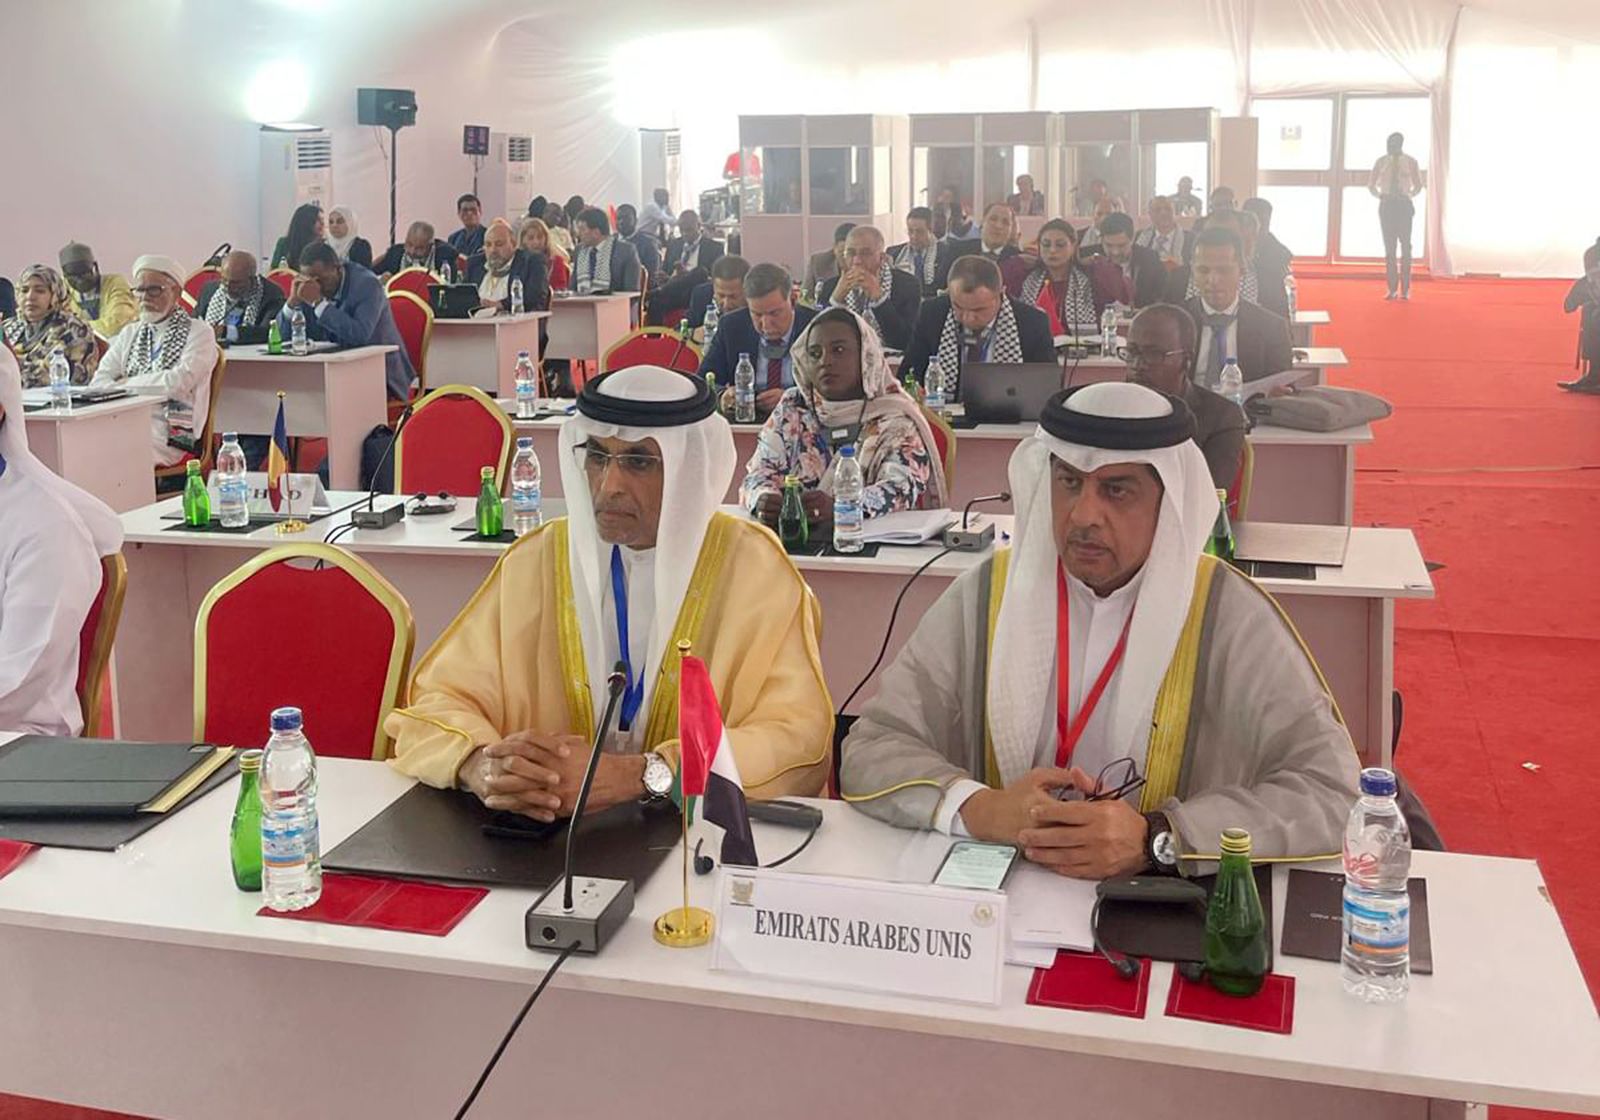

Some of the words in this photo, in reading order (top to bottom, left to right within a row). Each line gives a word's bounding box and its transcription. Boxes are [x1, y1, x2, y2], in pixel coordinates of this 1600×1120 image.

[754, 910, 839, 943] EMIRATS
[843, 920, 920, 953] ARABES
[926, 928, 972, 960] UNIS
